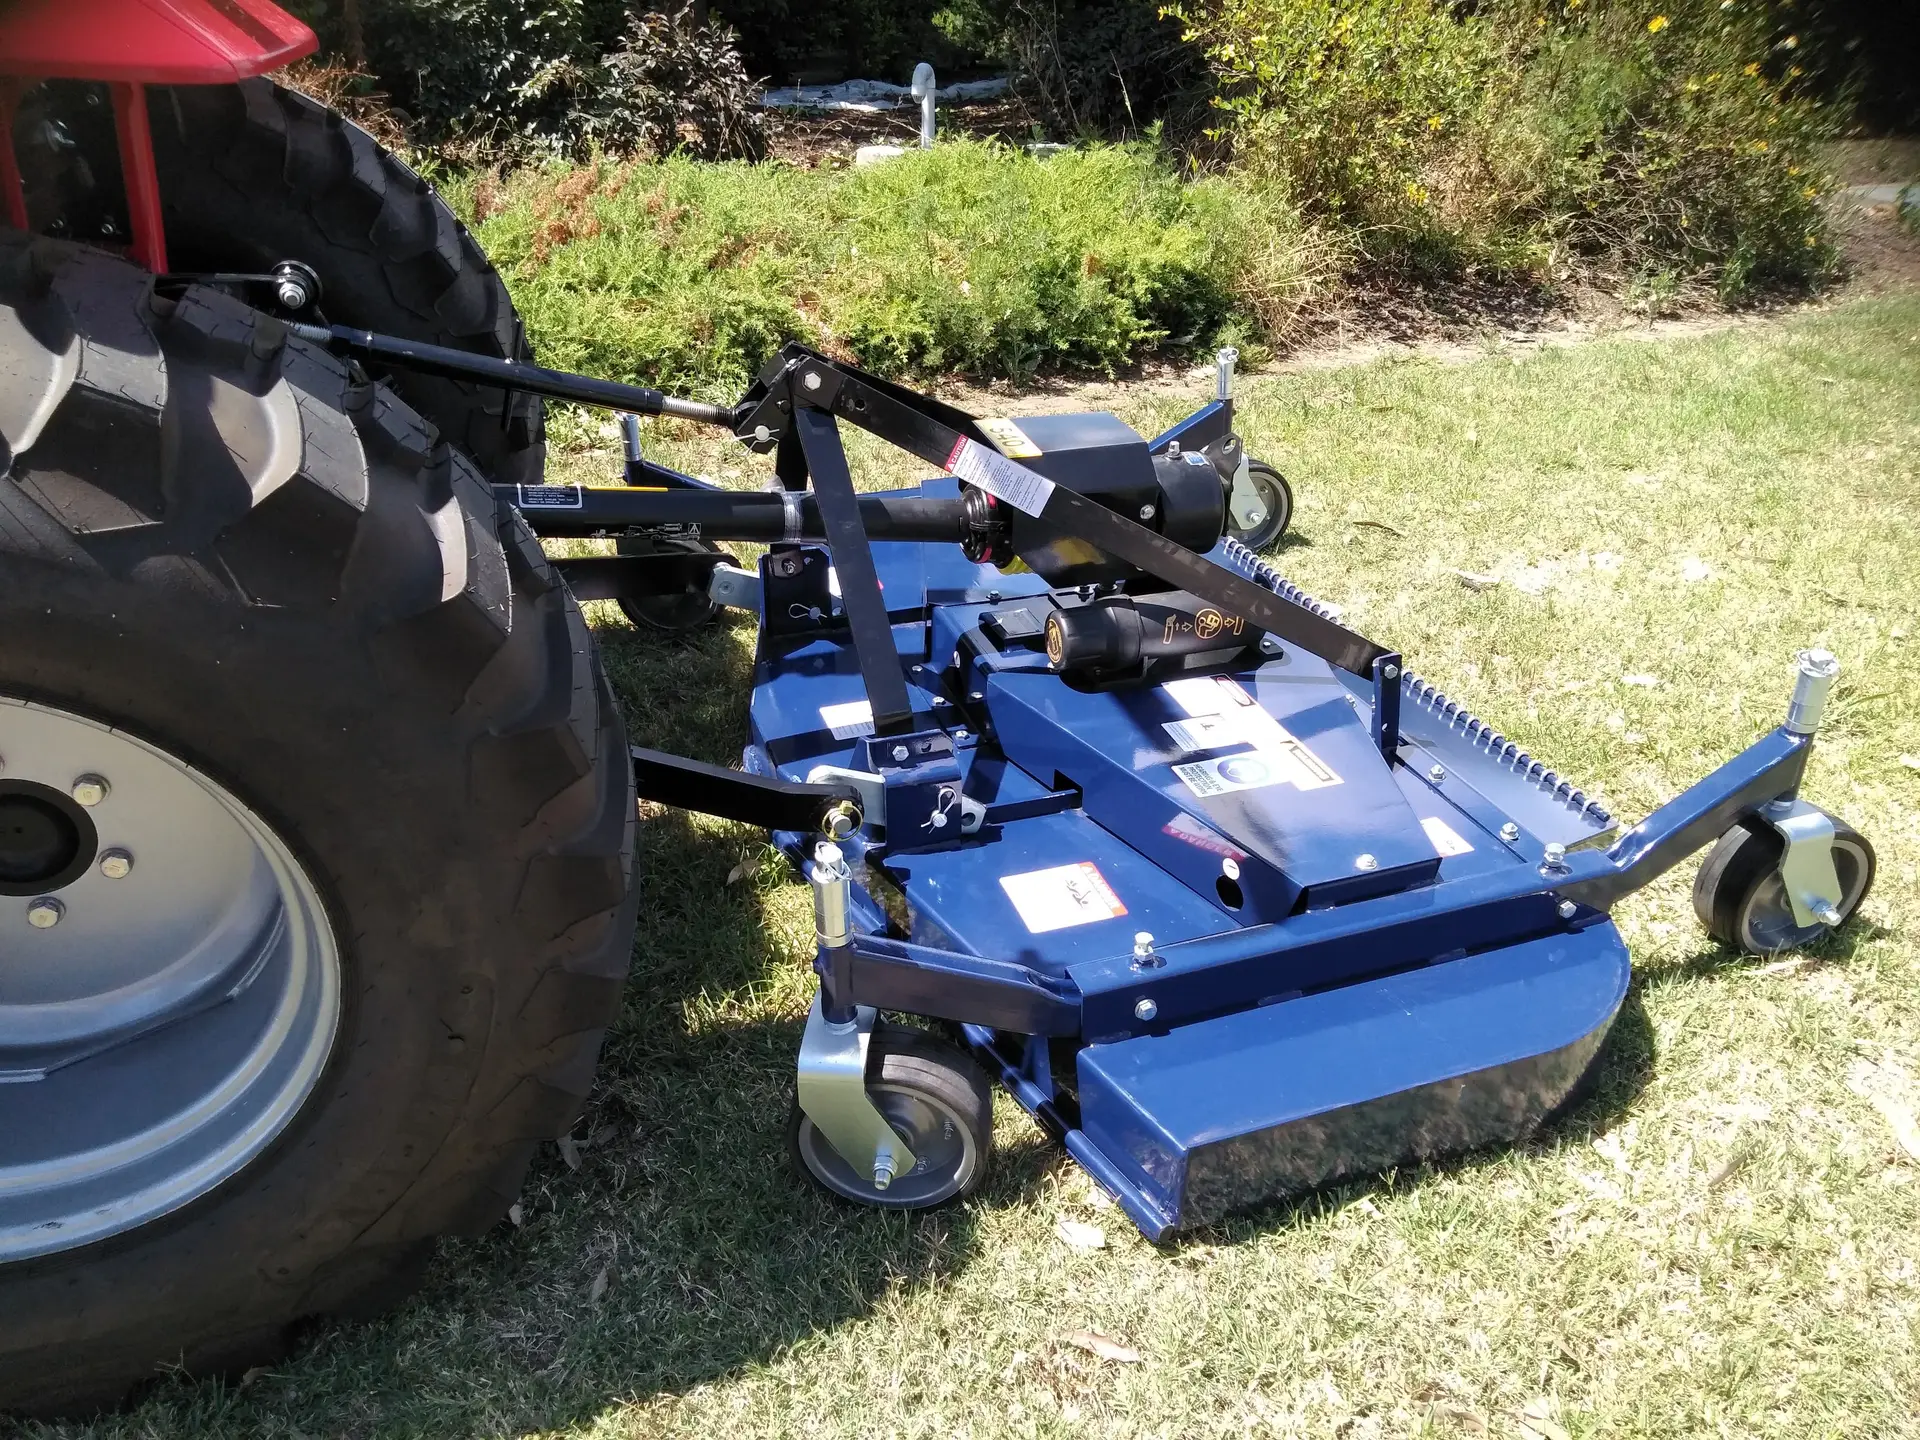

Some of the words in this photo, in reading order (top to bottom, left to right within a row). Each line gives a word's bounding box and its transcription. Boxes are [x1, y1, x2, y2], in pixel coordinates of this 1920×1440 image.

[989, 428, 1025, 447] 540
[951, 437, 968, 464] CAUTION
[1179, 766, 1194, 778] MUST
[1187, 766, 1213, 790] PROTECTION
[1193, 764, 1213, 780] HEARING
